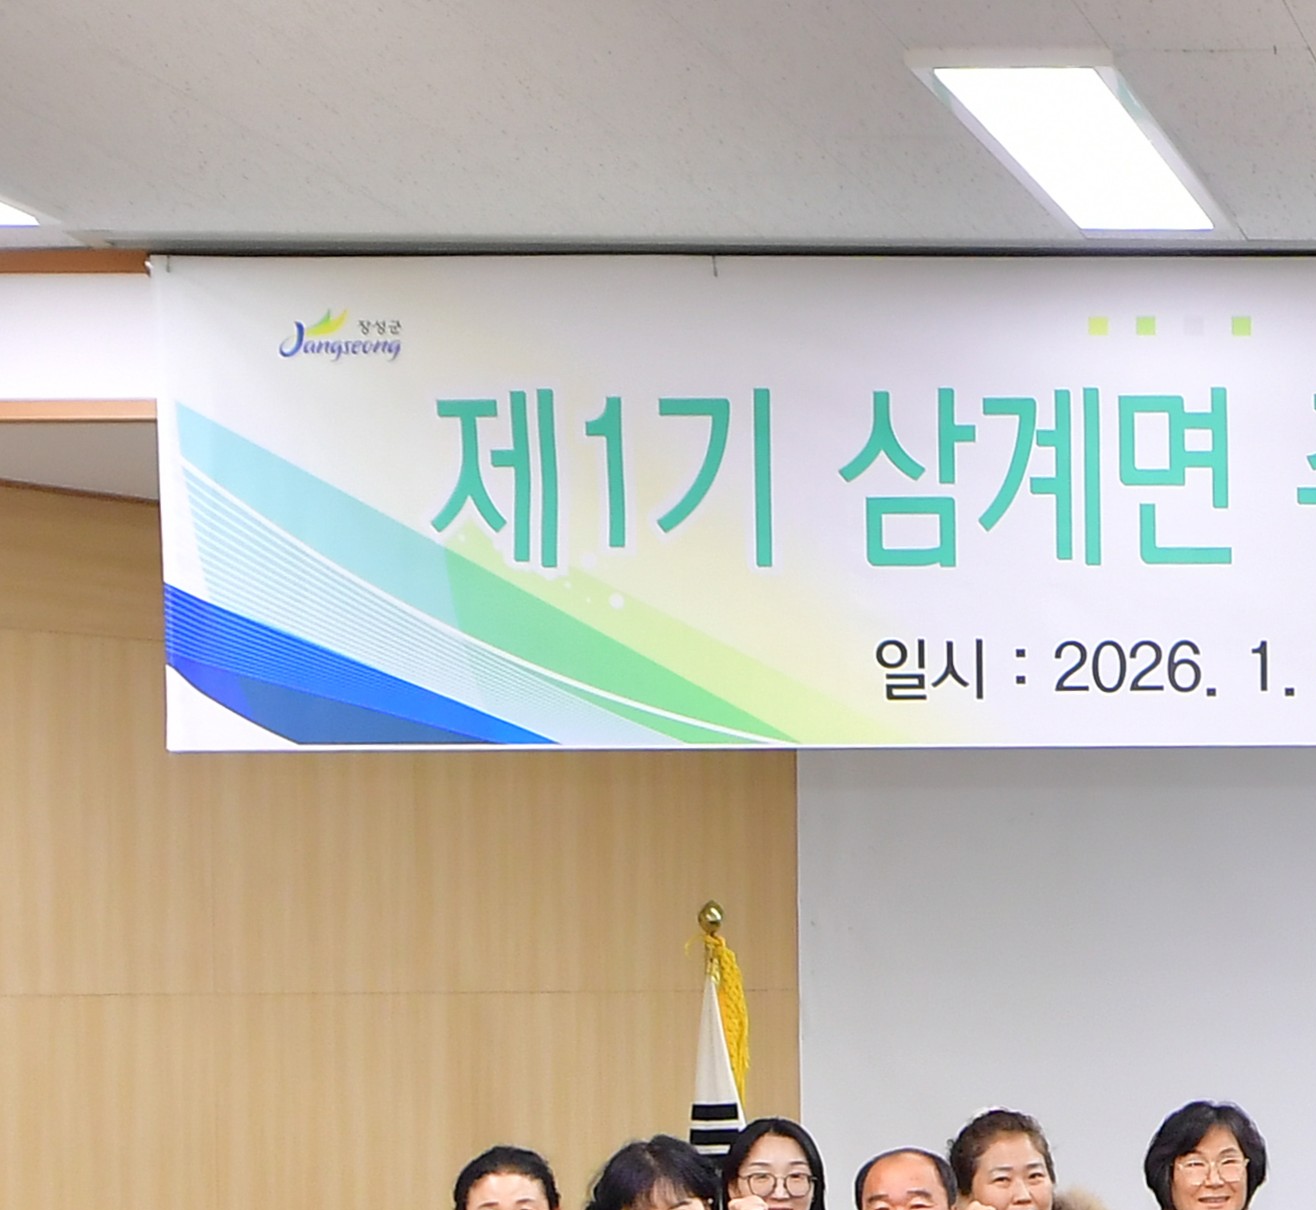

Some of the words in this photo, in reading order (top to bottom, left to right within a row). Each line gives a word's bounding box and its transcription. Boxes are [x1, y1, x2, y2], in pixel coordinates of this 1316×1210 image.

[279, 320, 402, 363] Jangseong
[358, 319, 402, 336] 장성군
[432, 388, 773, 568] 제1기
[839, 386, 1232, 568] 삼계면
[875, 637, 985, 702] 일시
[1052, 639, 1218, 697] 2026.
[1251, 640, 1296, 697] 1.
